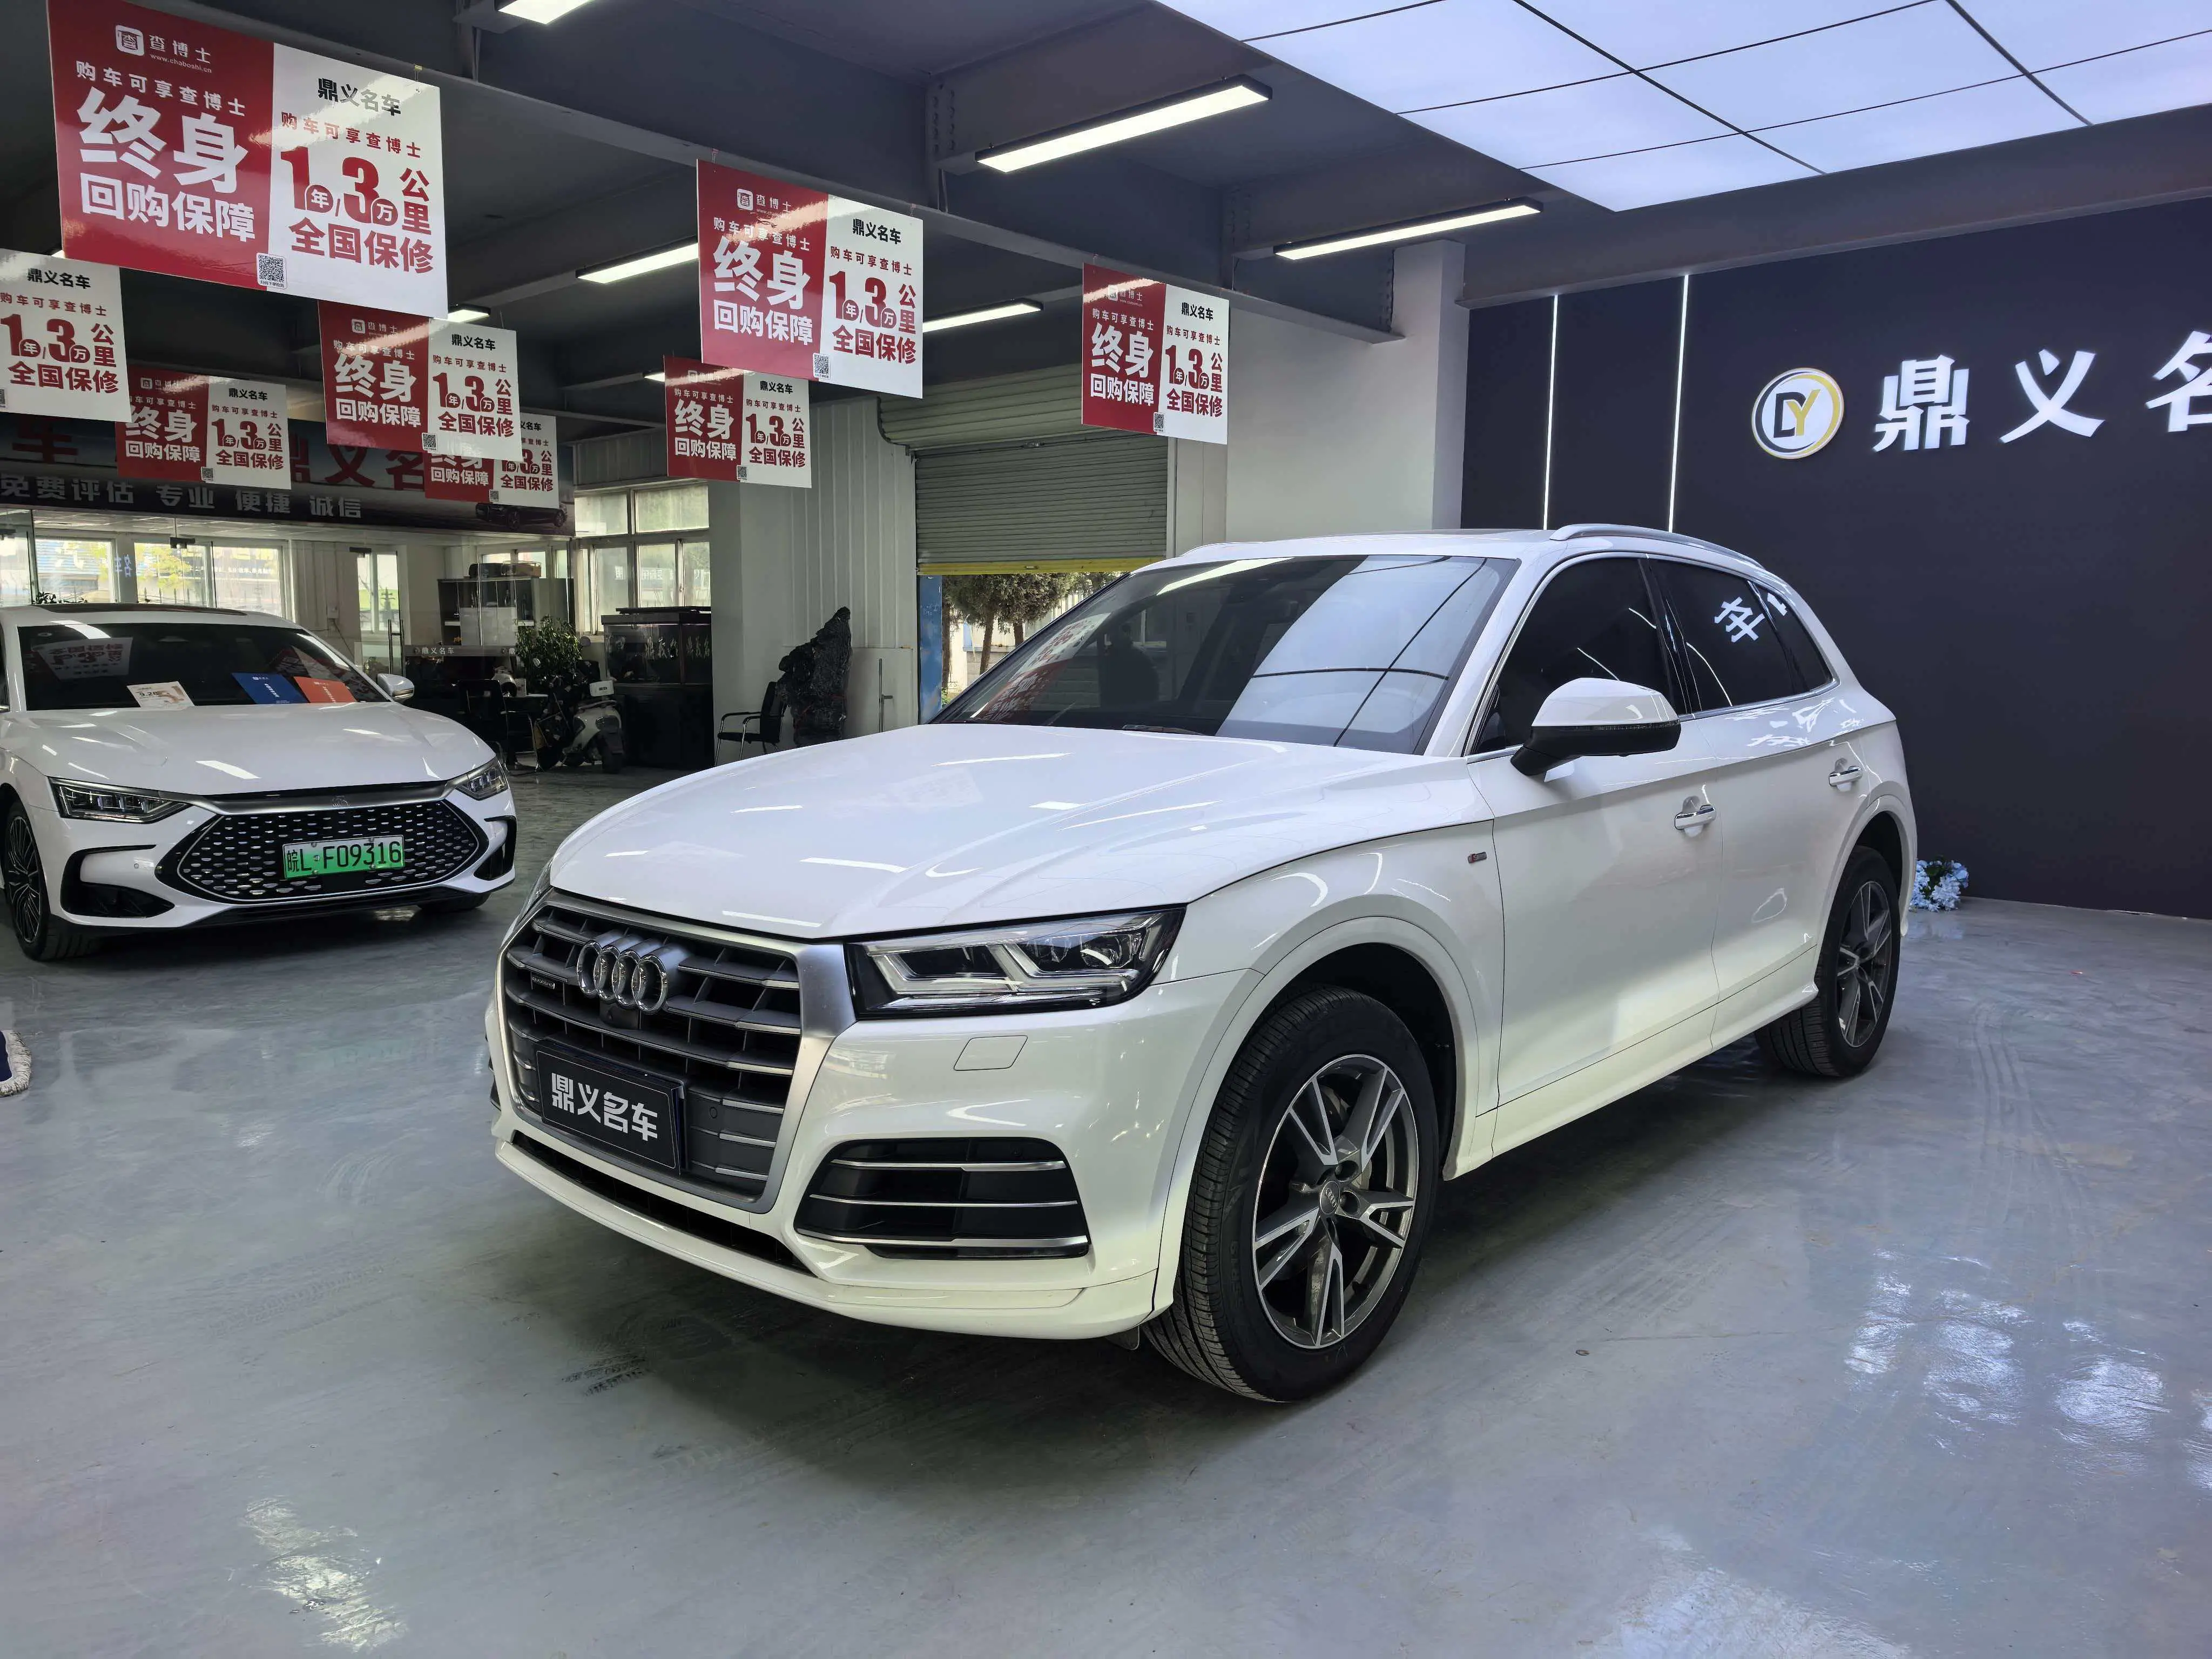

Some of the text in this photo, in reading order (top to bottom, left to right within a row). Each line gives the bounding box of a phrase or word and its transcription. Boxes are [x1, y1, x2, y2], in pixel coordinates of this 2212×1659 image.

[149, 35, 211, 64] 查博士
[150, 54, 212, 73] www.chaboshi.cn
[76, 60, 245, 116] 购车可享查博士
[318, 78, 401, 116] 鼎义名车
[77, 86, 248, 193] 终身
[281, 112, 421, 158] 购车可享查博士
[80, 173, 254, 242] 回购保障
[757, 194, 791, 213] 查博士
[714, 217, 810, 251] 购车可享查博士
[852, 218, 901, 245] 鼎义名车
[289, 218, 434, 274] 全国保修
[713, 236, 810, 310] 终身
[830, 246, 912, 276] 购车可享查博士
[28, 268, 91, 289] 鼎义名车
[0, 292, 107, 316] 购车可享查博士
[1182, 302, 1213, 321] 鼎义名车
[713, 300, 812, 345] 回购保障
[1092, 308, 1154, 330] 购车可享查博士
[452, 334, 496, 350] 鼎义名车
[833, 325, 916, 365] 全国保修
[1166, 325, 1220, 346] 购车可享查博士
[334, 340, 415, 360] 购车可享查博士
[1091, 322, 1153, 377] 终身
[433, 354, 507, 373] 购车可享查博士
[8, 361, 119, 394] 全国保修
[335, 354, 416, 402] 终身
[760, 381, 793, 394] 鼎义名车
[1090, 374, 1154, 406] 回购保障
[130, 396, 196, 409] 车可享查博士
[229, 388, 268, 401] 鼎义名车
[675, 389, 733, 403] 购车可享查博士
[746, 399, 801, 412] 购车可享查博士
[1166, 388, 1223, 417] 全国保修
[1872, 331, 2212, 453] 鼎义名
[125, 404, 197, 443] 终身
[212, 404, 278, 419] 购车可享查博士
[336, 398, 421, 428] 回购保障
[438, 411, 514, 437] 全国保修
[675, 399, 733, 439] 终身
[126, 441, 200, 462] 回购保障
[215, 449, 284, 470] 全国保修
[675, 437, 737, 461] 回购保障
[749, 446, 805, 468] 全国保修
[431, 467, 488, 486] 回购保障
[500, 474, 553, 491] 全国保修
[0, 473, 361, 518] 免费评估 专业 便捷 诚信
[551, 1073, 658, 1141] 鼎义名车
